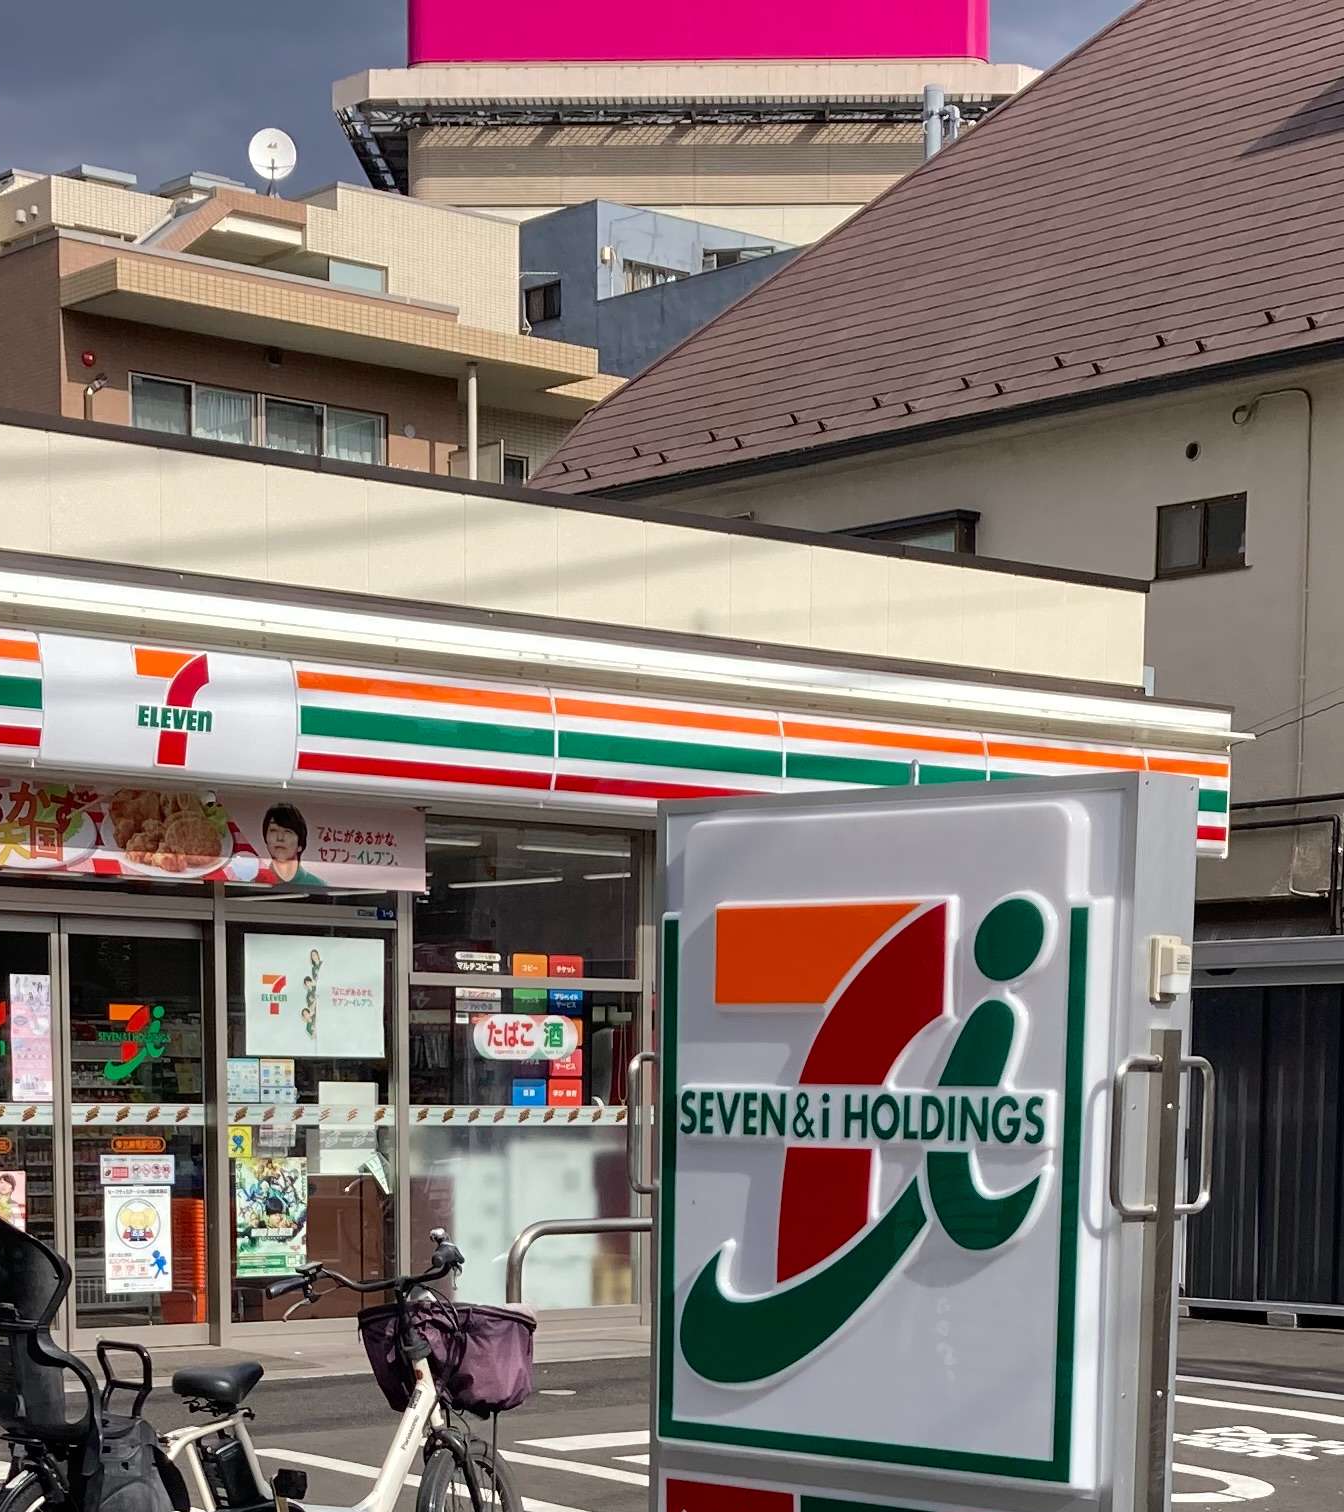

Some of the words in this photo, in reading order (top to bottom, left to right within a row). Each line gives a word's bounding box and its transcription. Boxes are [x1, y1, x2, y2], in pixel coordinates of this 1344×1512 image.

[487, 1021, 535, 1047] たばこ
[544, 1022, 564, 1048] 酒
[843, 1094, 1045, 1144] HOLDINGS
